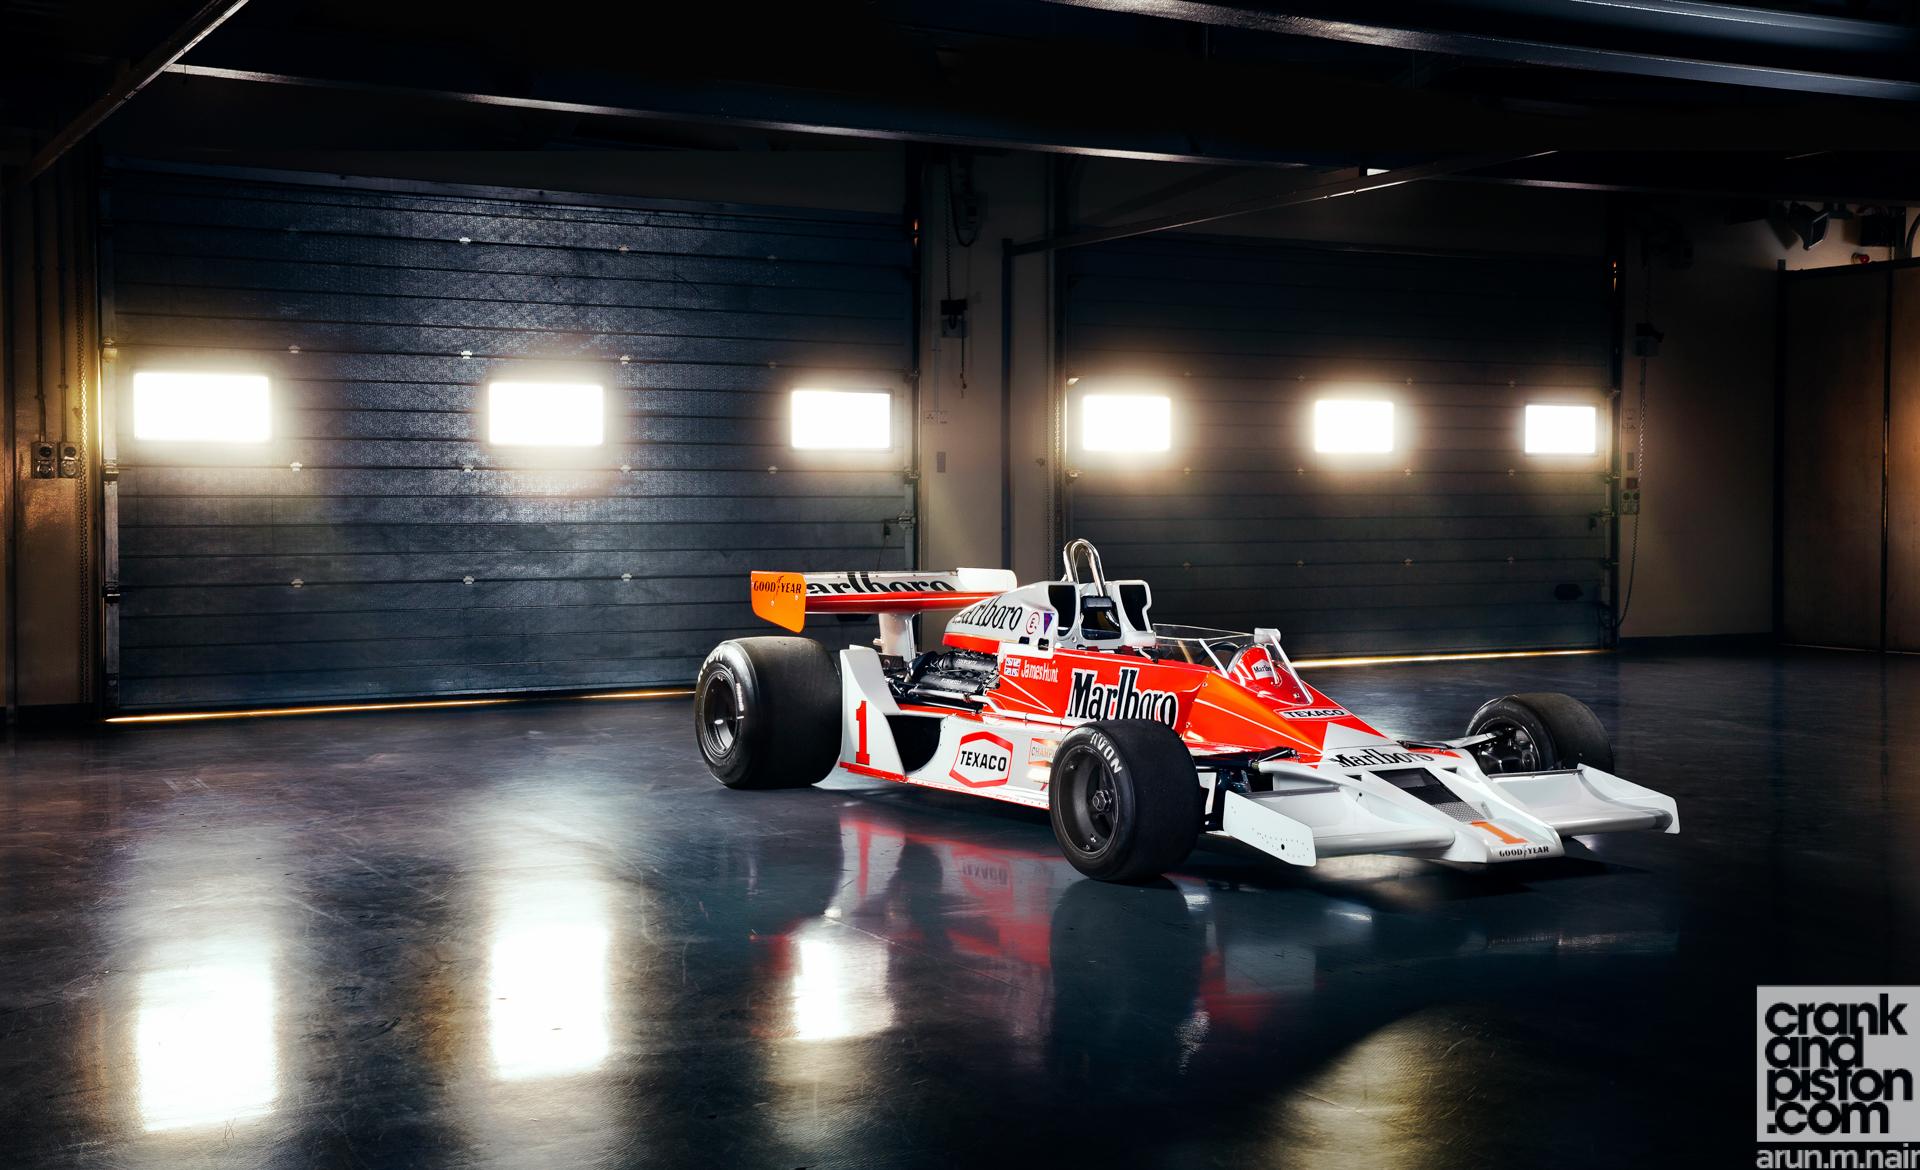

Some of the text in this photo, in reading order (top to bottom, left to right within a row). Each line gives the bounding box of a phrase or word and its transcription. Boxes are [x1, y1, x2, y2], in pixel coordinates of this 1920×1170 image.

[753, 580, 802, 594] GOOD YEAR
[806, 572, 957, 595] arlboro
[1066, 668, 1177, 728] Marlboro
[1283, 709, 1346, 718] TEXACO
[855, 700, 870, 766] 1
[960, 750, 1007, 772] TEXACO
[1090, 732, 1122, 774] AVON
[1328, 748, 1436, 768] Marlboro
[1471, 820, 1528, 845] 1
[1499, 846, 1549, 857] GOOD YEAR
